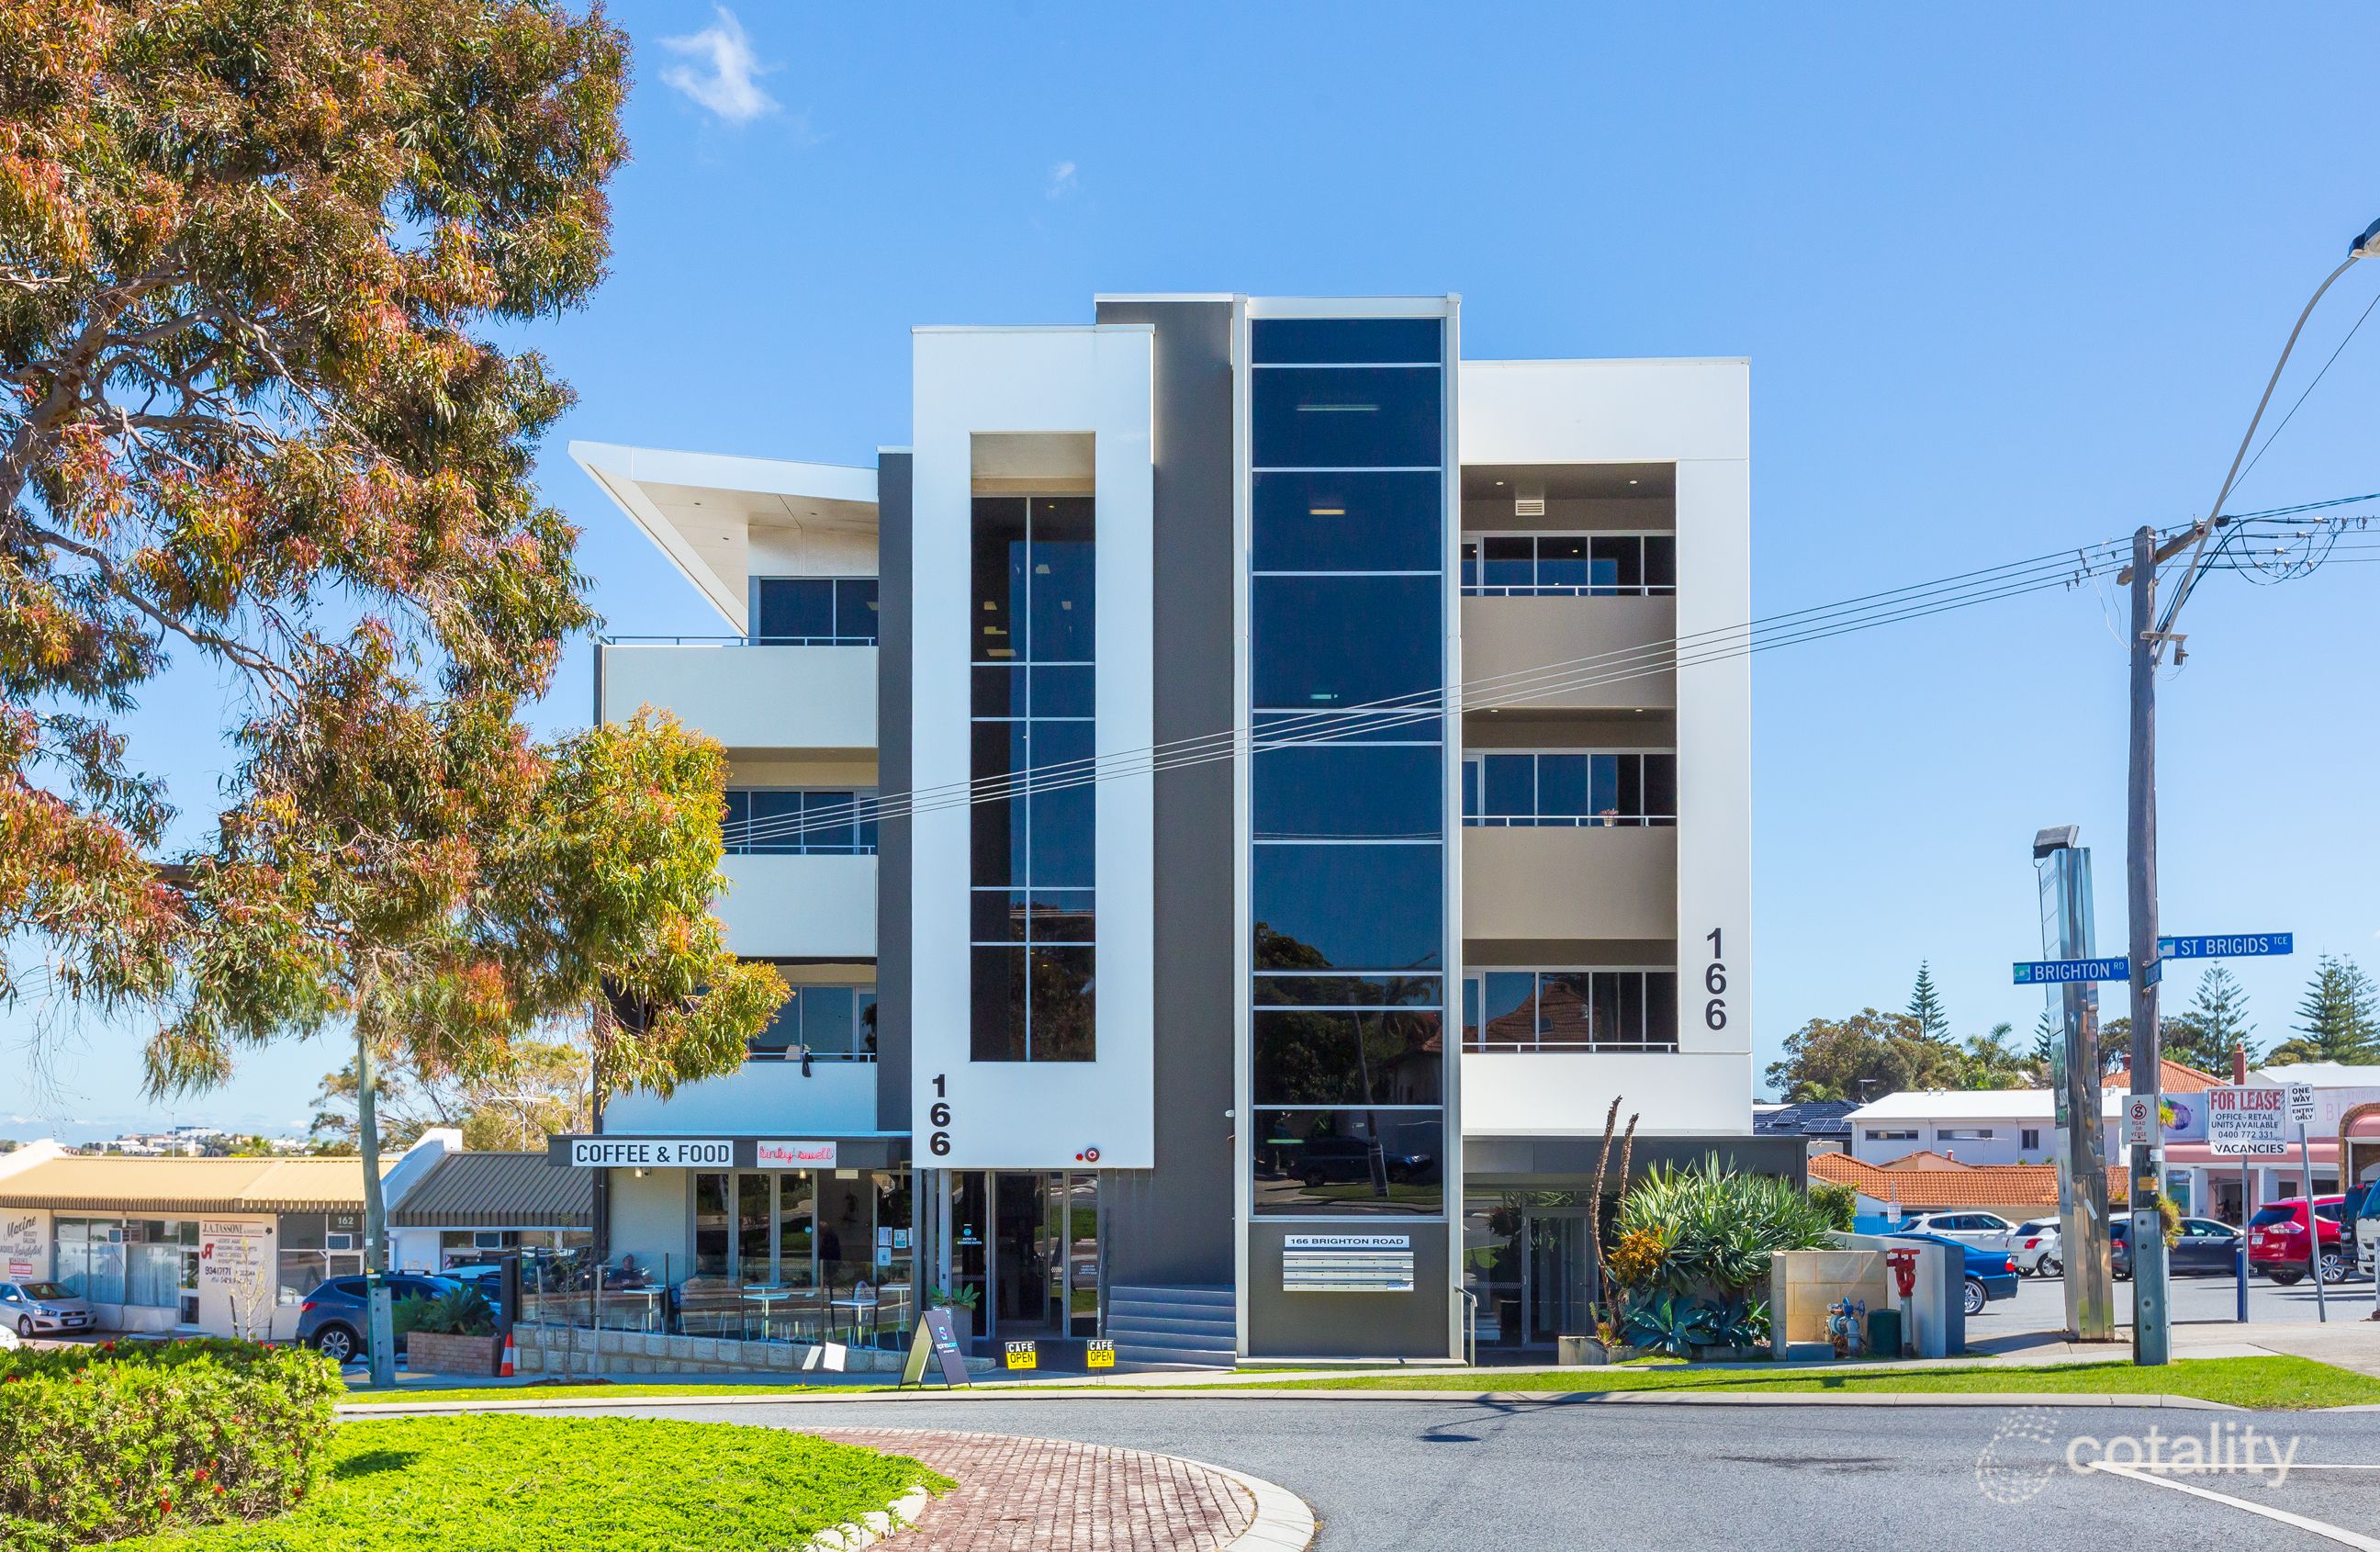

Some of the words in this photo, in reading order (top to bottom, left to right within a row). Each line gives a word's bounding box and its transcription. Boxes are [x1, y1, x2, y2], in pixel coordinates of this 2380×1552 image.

[2181, 939, 2198, 955] ST
[2206, 937, 2269, 954] BRIGIDS
[2273, 936, 2288, 945] TCE
[2035, 962, 2110, 981] BRIGHTON
[2113, 962, 2125, 971] RD
[1705, 928, 1726, 1030] 166
[2210, 1091, 2236, 1110] FOR
[2240, 1091, 2281, 1110] LEASE
[929, 1074, 951, 1156] 166
[2217, 1130, 2239, 1139] 0400
[2241, 1130, 2256, 1139] 772
[2259, 1130, 2273, 1139] 331
[576, 1144, 649, 1163] COFFEE
[657, 1146, 670, 1163] &
[678, 1145, 730, 1163] FOOD
[2215, 1144, 2285, 1153] VACANCIES
[338, 1216, 354, 1225] 162
[1008, 1343, 1033, 1353] CAFE
[1090, 1341, 1113, 1350] CAFE
[1010, 1353, 1033, 1364] OPEN
[1090, 1351, 1112, 1361] OPEN
